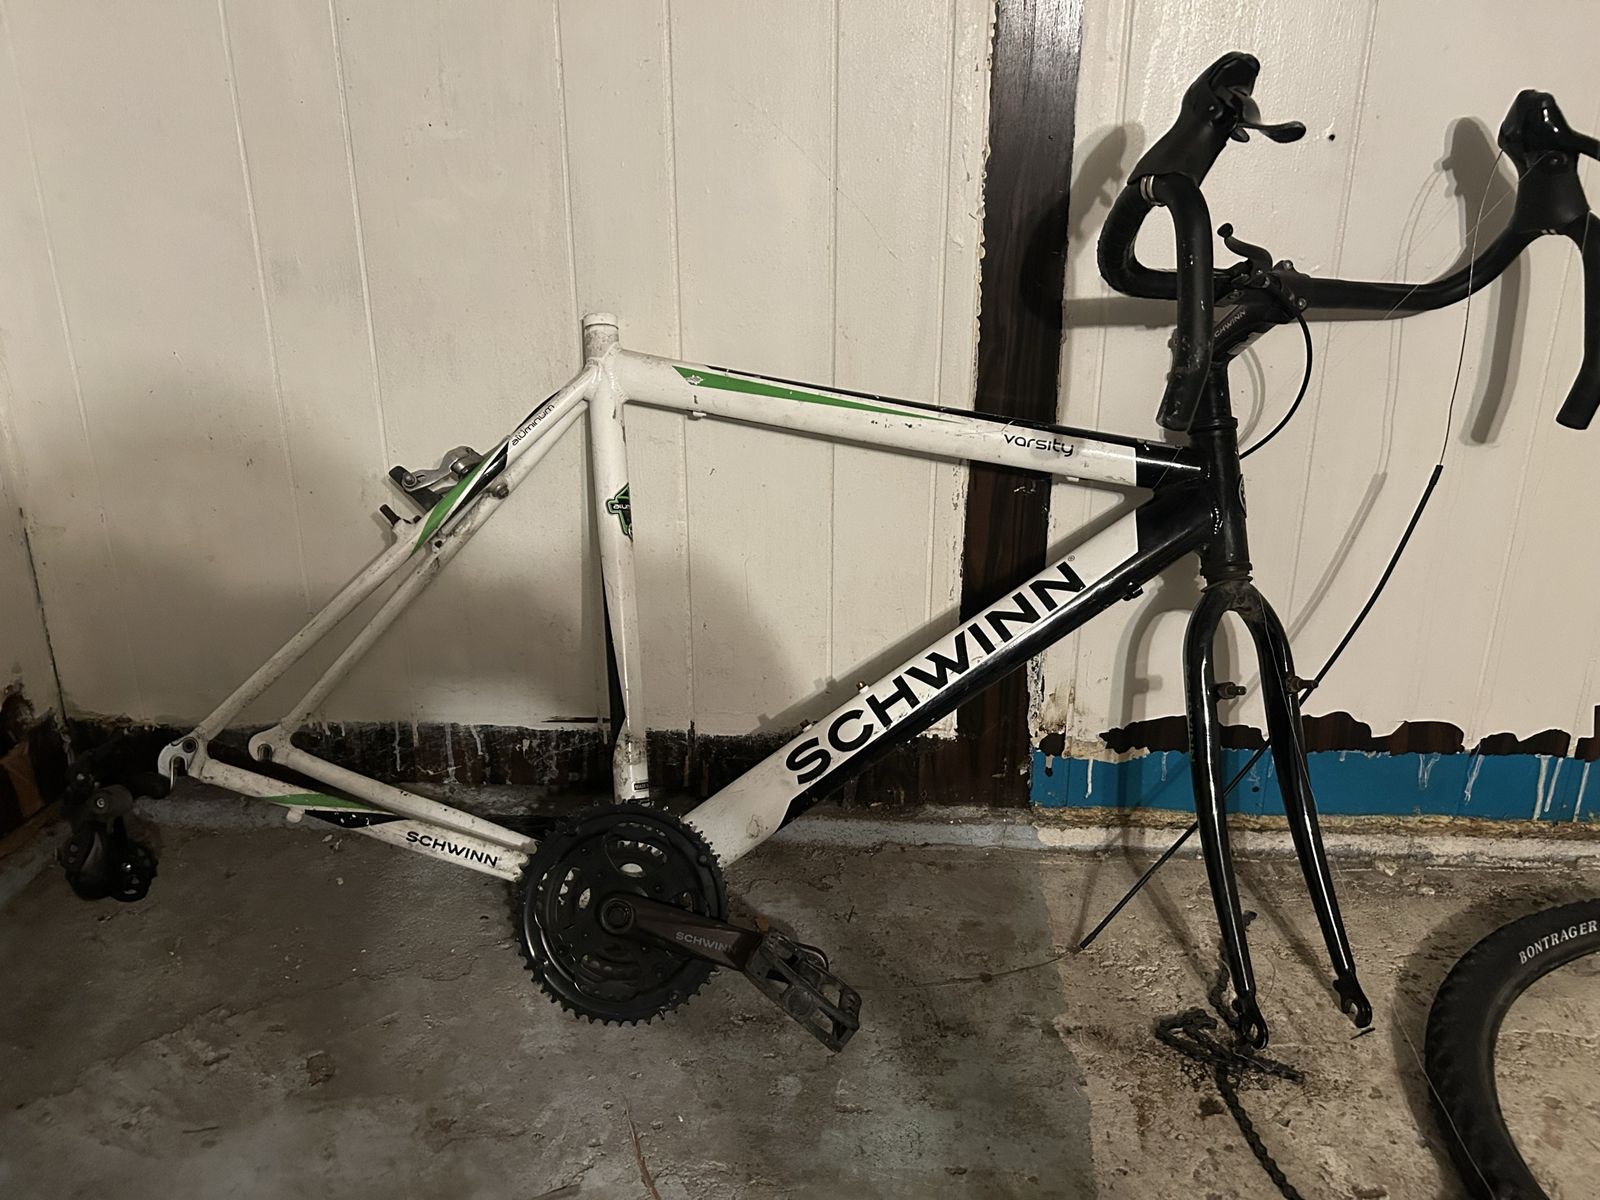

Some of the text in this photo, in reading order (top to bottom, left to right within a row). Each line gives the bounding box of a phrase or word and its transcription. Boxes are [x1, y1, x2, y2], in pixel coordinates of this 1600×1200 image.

[1214, 309, 1246, 338] CHWINN
[1004, 434, 1074, 457] varsity
[785, 560, 1087, 785] SCHWINN
[405, 831, 498, 867] SCHWINN
[1518, 920, 1598, 965] BONTRAGER
